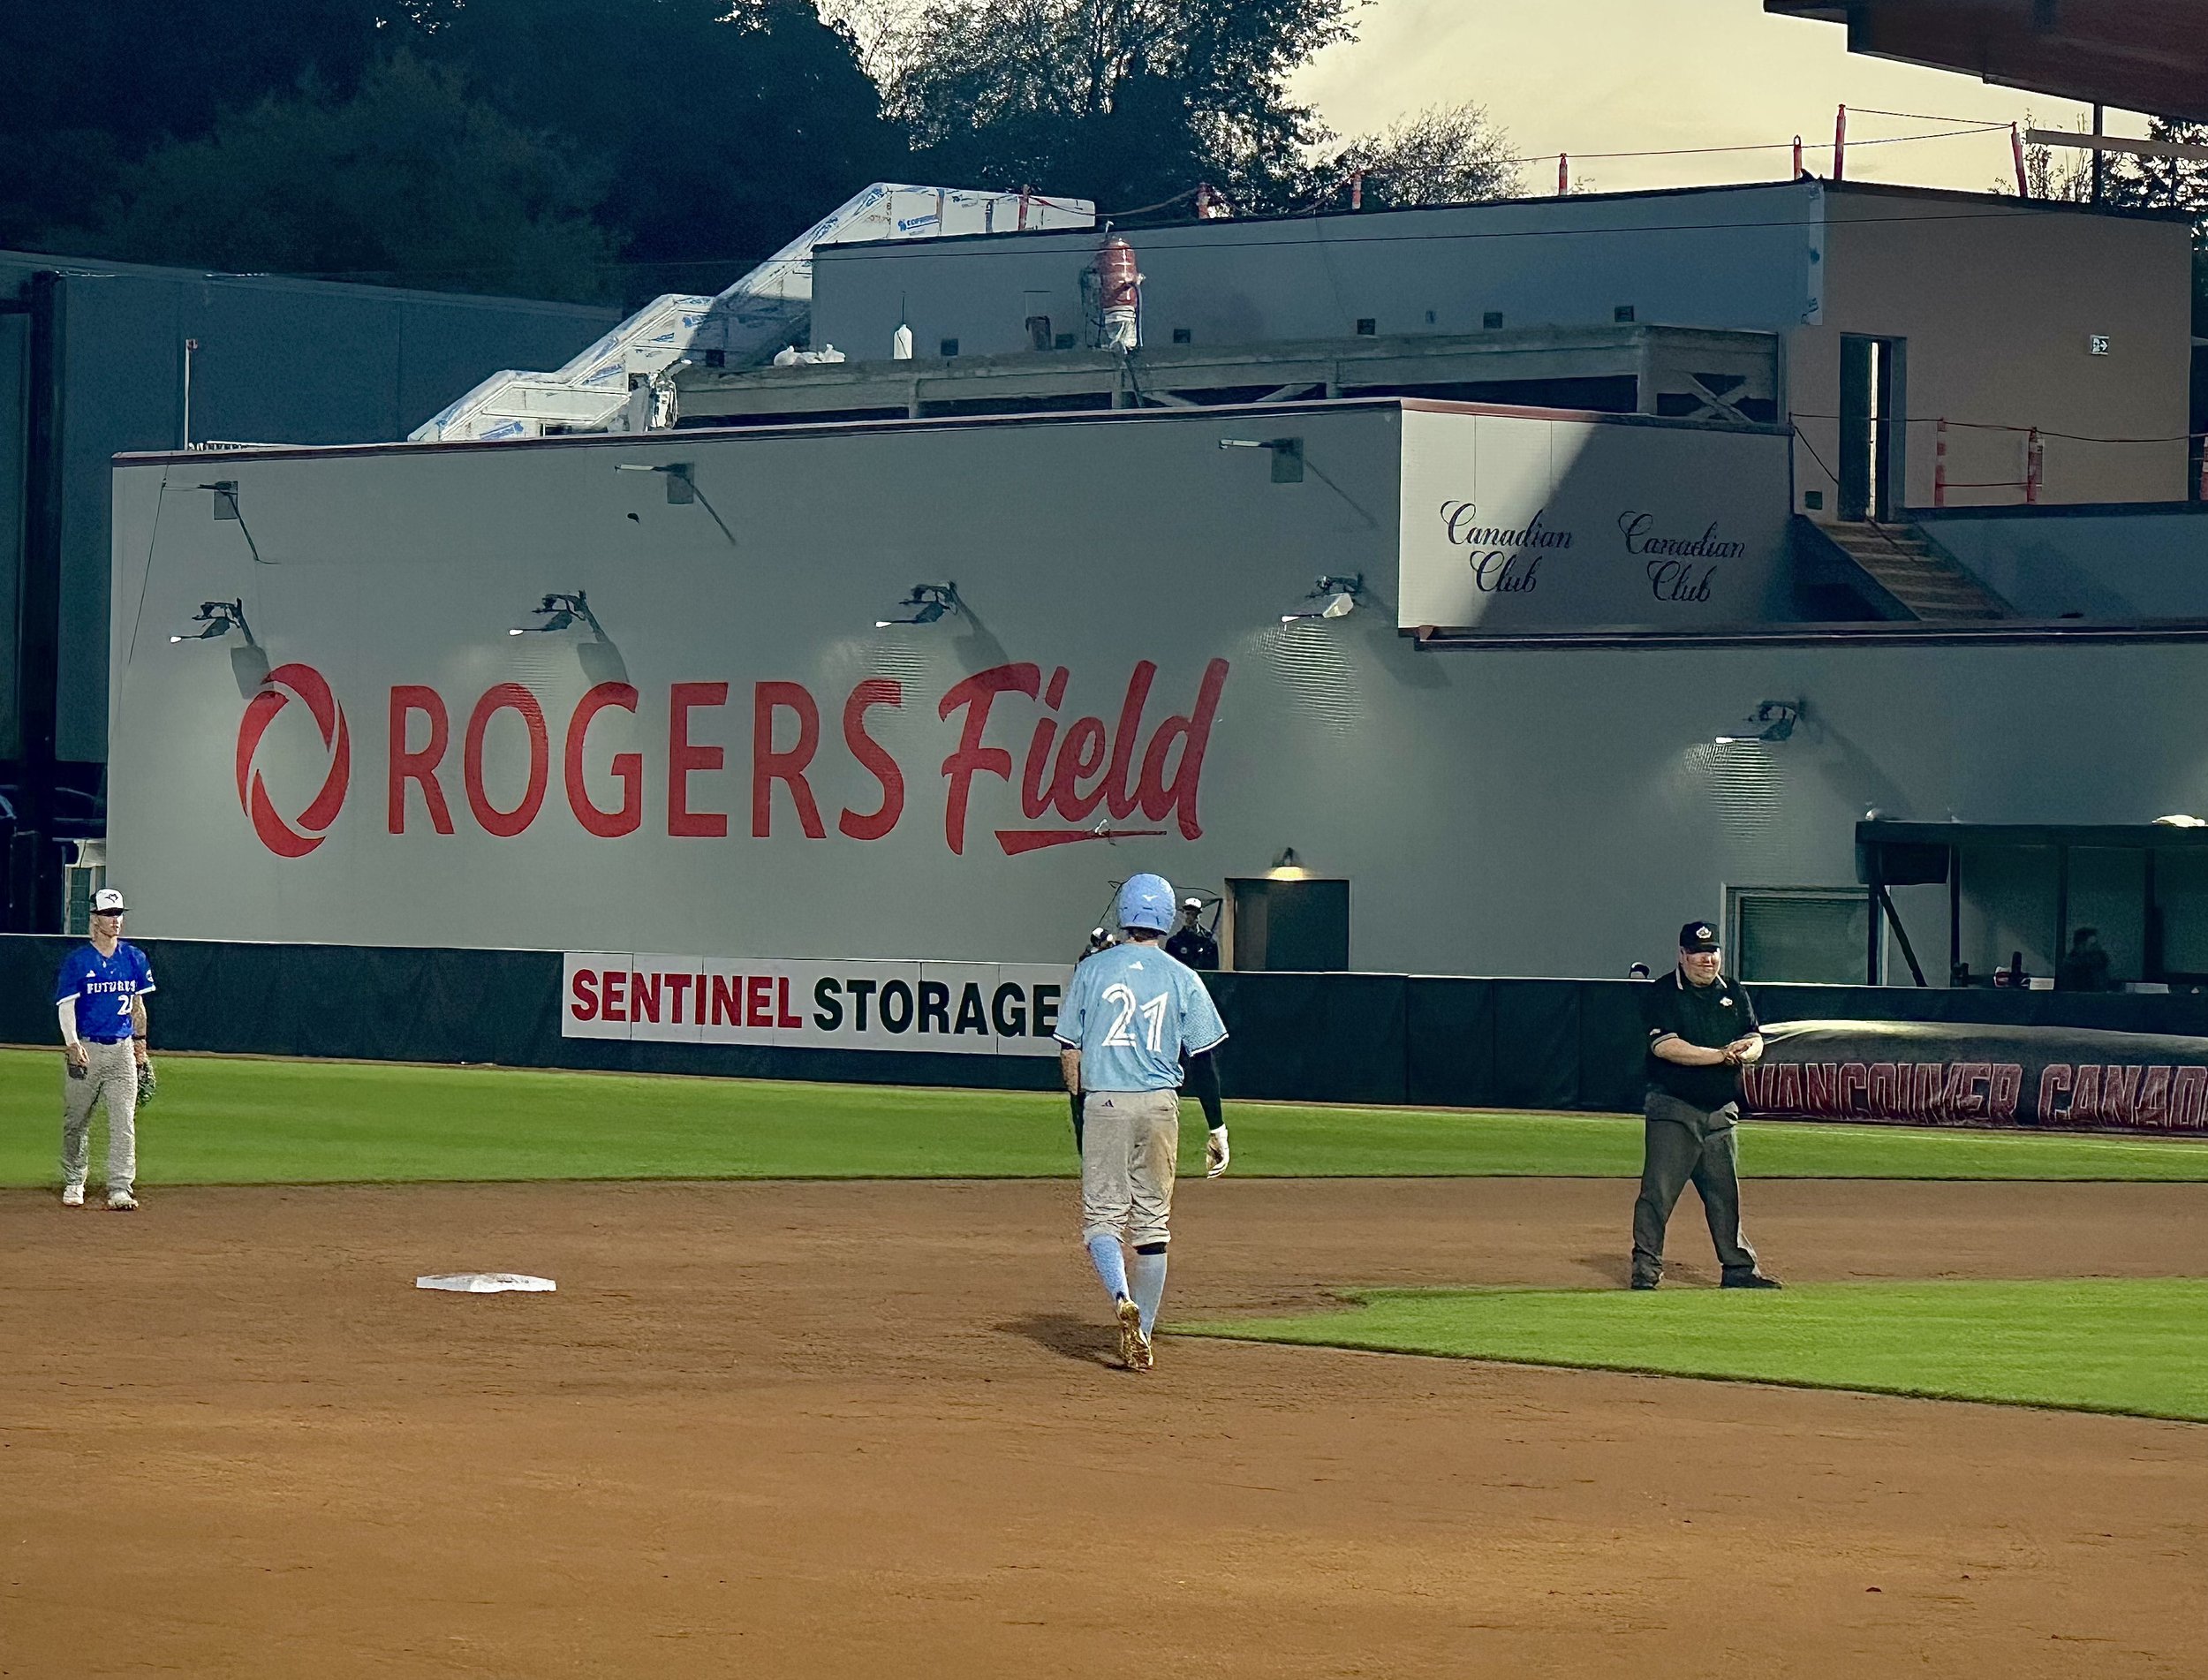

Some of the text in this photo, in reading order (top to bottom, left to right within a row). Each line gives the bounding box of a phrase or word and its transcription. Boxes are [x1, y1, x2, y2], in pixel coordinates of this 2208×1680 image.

[1440, 500, 1574, 549] Canadian
[1618, 511, 1745, 559] Canadian
[1470, 550, 1543, 594] Club
[1647, 560, 1717, 602] Club
[389, 657, 1230, 856] ROGERS Field
[87, 980, 136, 995] FUTURES
[571, 969, 1061, 1037] SENTINEL STORAGE
[1101, 983, 1168, 1053] 21
[1743, 1063, 2208, 1131] VANCOUVER CANAD
